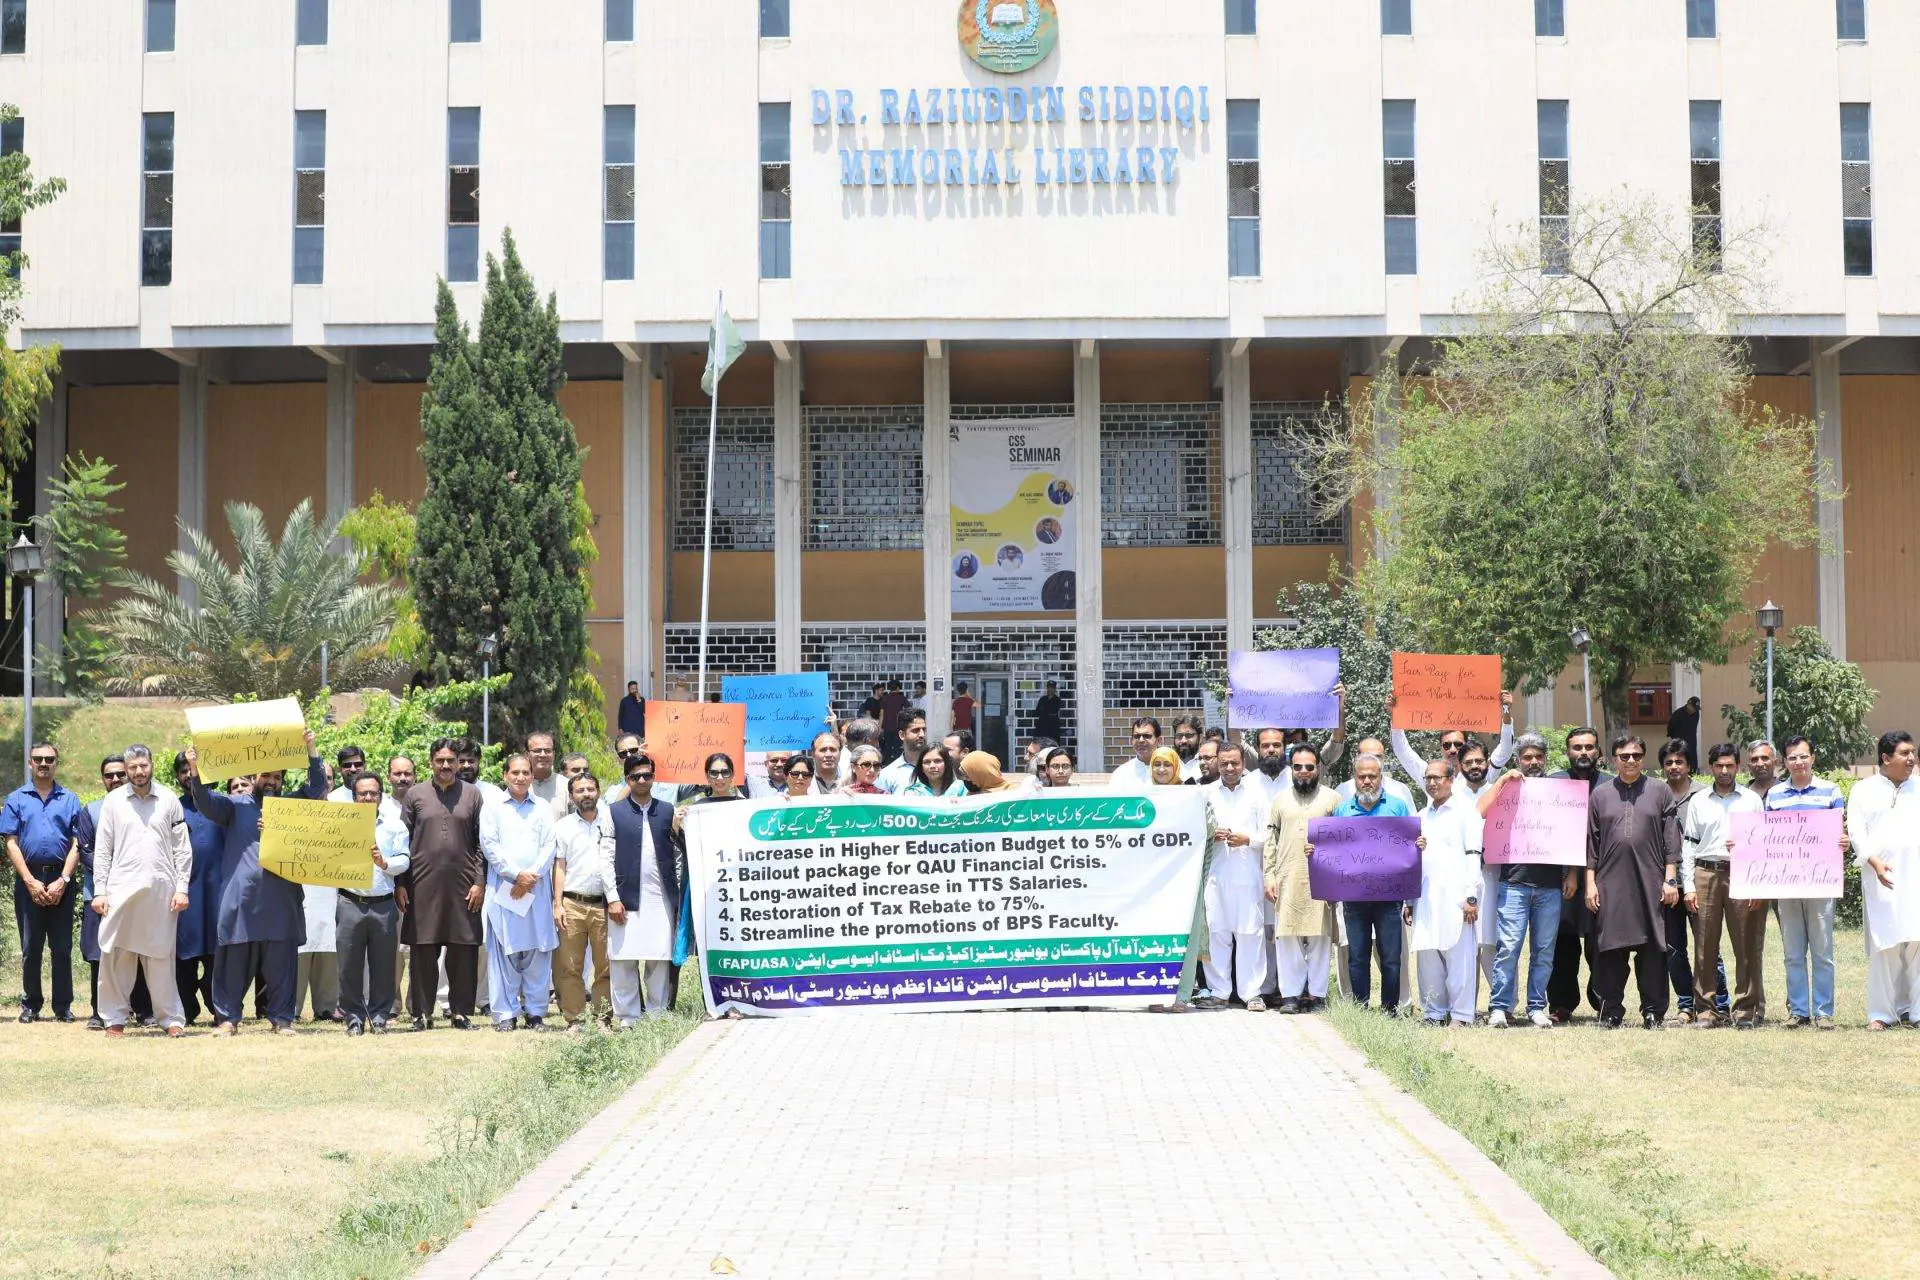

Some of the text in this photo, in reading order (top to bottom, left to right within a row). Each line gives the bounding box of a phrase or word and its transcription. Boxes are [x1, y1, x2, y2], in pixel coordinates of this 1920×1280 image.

[811, 85, 1210, 129] DR. RAZIUDDIN SIDDIQI
[839, 147, 1180, 186] MEMORIAL LIBRARY
[1008, 435, 1026, 447] CSS
[1009, 447, 1061, 462] SEMINAR
[883, 814, 918, 828] 500
[716, 832, 1193, 862] 1. Increase in Higher Education Budget to 5% of GDP.
[279, 861, 307, 878] TTS
[717, 855, 1107, 883] 2. Bailout package for QAU Financial Crisis.
[718, 875, 1088, 903] 3. Long-awaited increase in TTS Salaries.
[719, 896, 1045, 922] 4. Restoration of Tax Rebate to 75%.
[719, 913, 1119, 943] 5. Streamline the promotions of BPS Faculty.
[1050, 943, 1101, 960] پاکستان
[1138, 940, 1187, 959] یڈریشن
[1128, 966, 1183, 987] یڈمک
